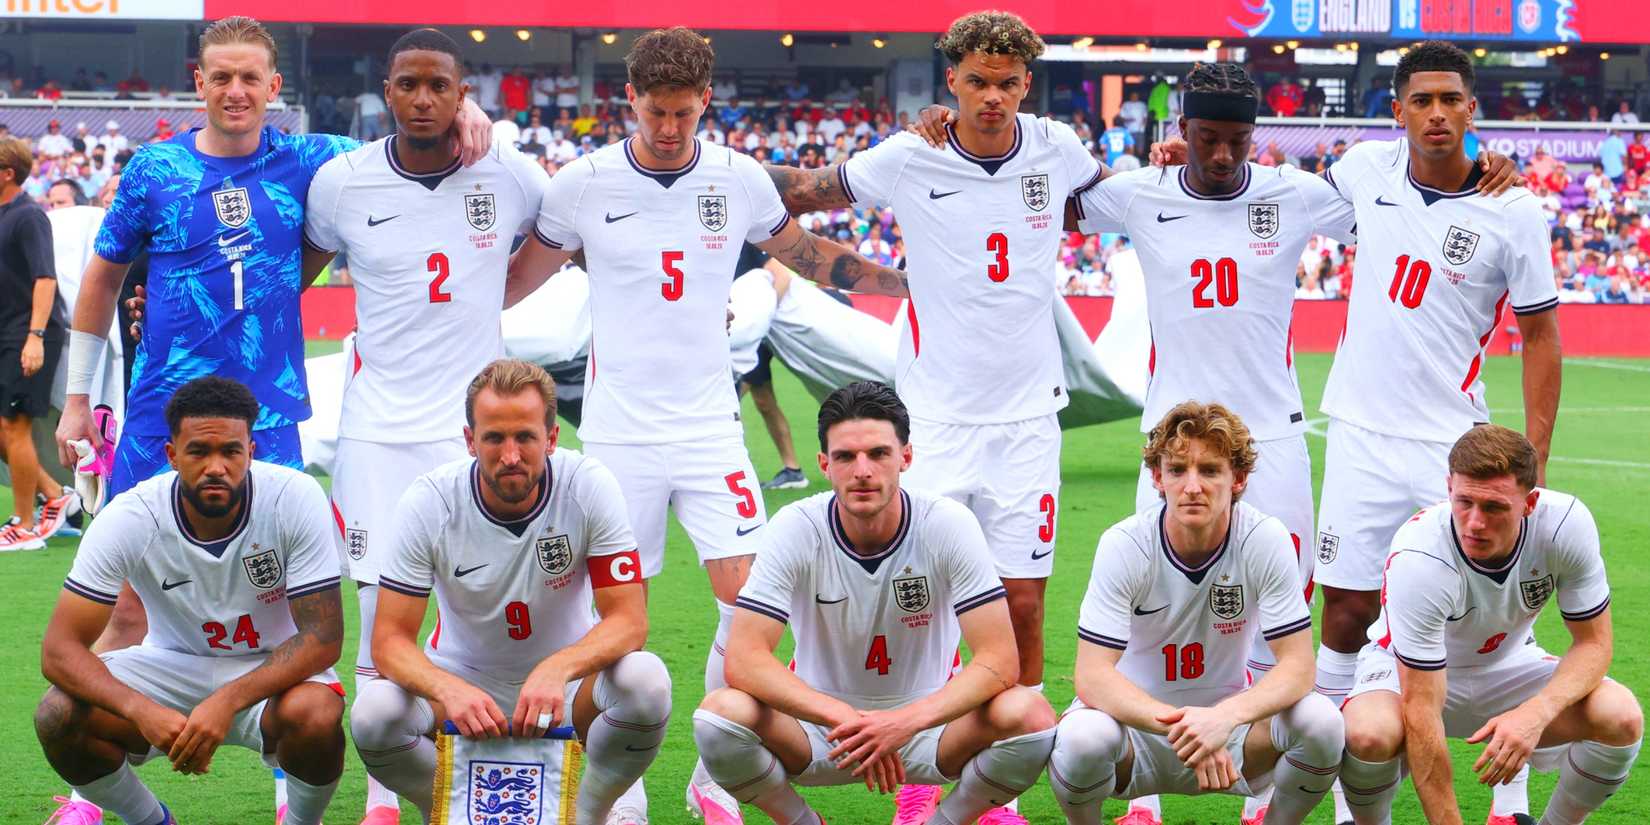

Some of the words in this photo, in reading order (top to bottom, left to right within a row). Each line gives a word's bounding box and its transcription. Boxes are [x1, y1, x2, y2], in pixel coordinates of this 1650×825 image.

[1517, 138, 1601, 158] STADIUM
[427, 252, 451, 303] 2
[661, 251, 684, 301] 5
[987, 233, 1009, 282] 3
[1388, 254, 1432, 309] 10
[230, 261, 243, 310] 1
[1190, 257, 1239, 308] 20
[724, 470, 757, 519] 5
[1039, 493, 1055, 543] 3
[610, 556, 635, 582] C
[201, 614, 261, 650] 24
[505, 601, 532, 640] 9
[1213, 622, 1232, 630] COSTA
[865, 635, 892, 676] 4
[1162, 642, 1205, 681] 18
